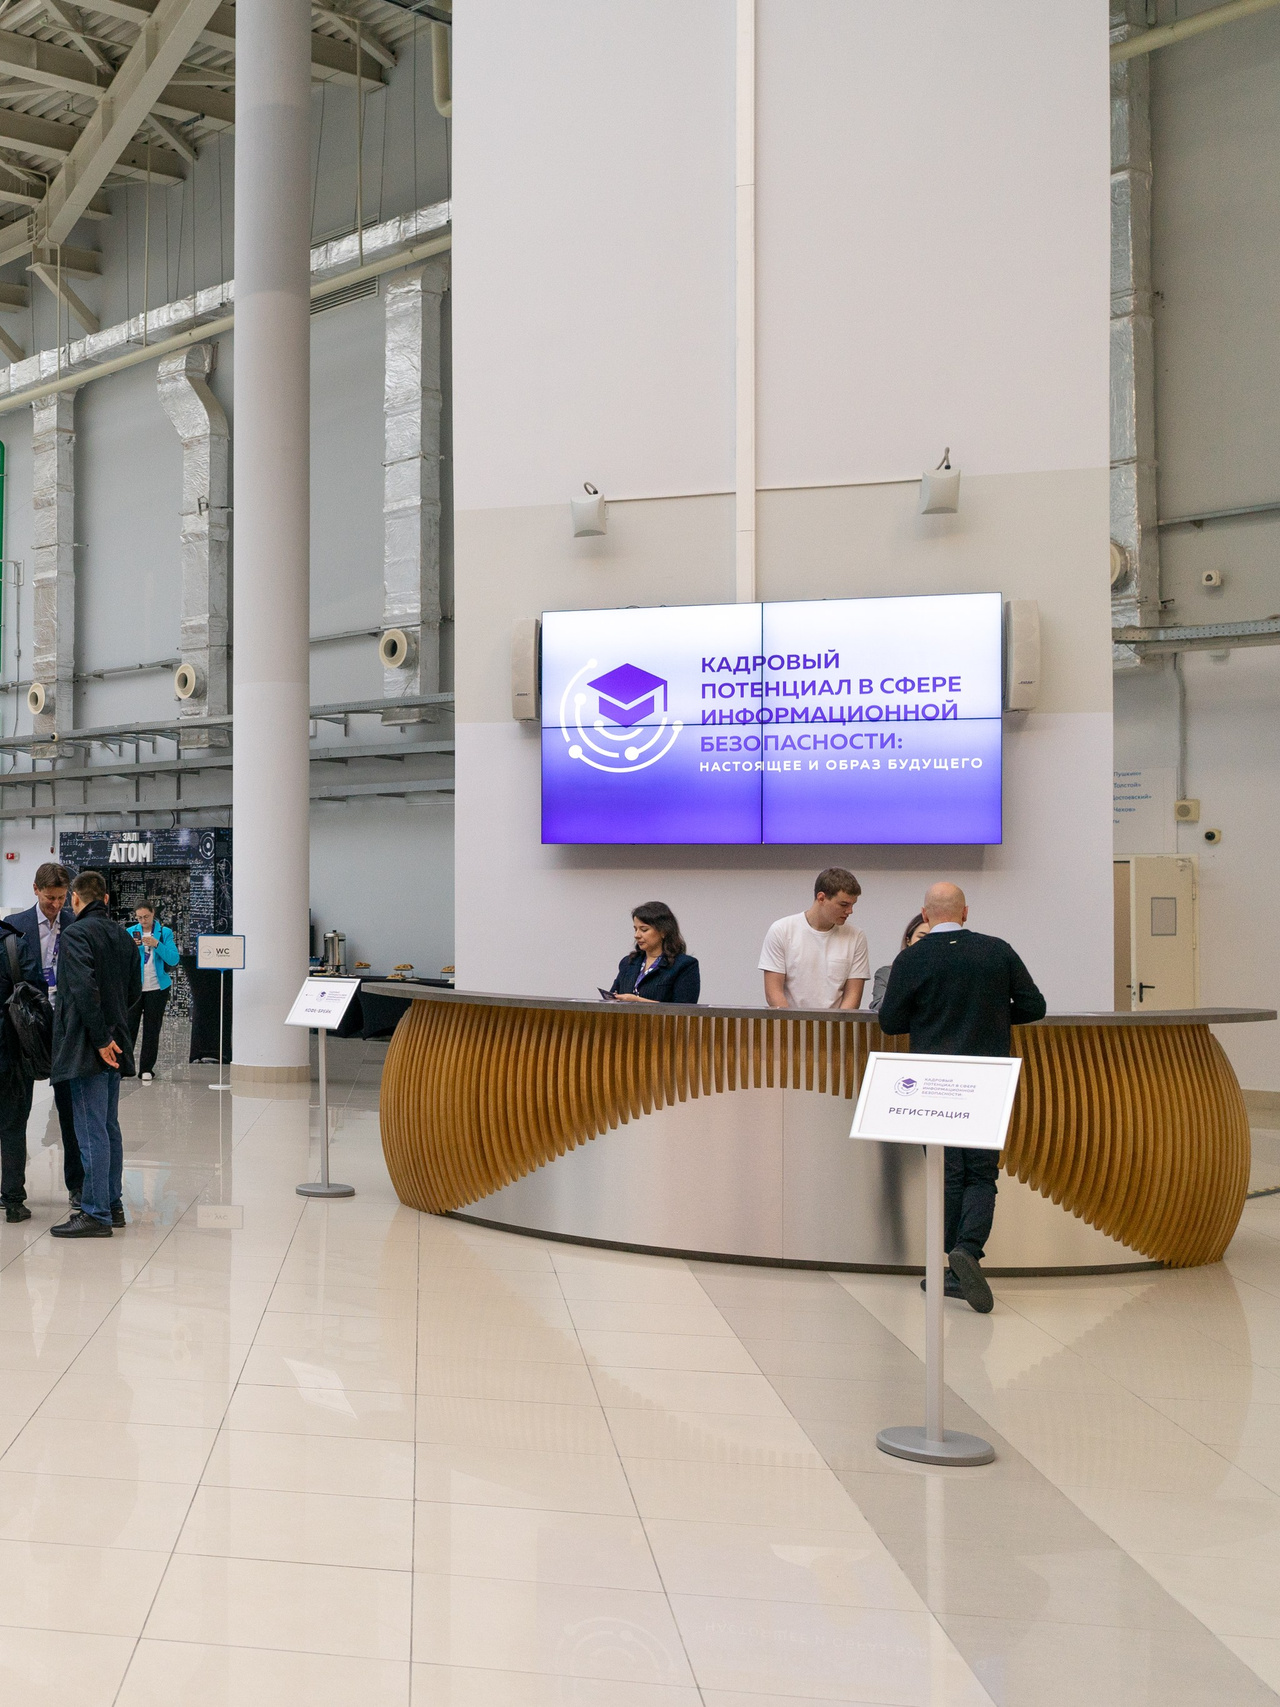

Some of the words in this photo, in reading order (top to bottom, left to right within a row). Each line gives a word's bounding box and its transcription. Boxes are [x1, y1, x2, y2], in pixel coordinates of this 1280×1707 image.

[701, 649, 840, 675] КАДРОВЫЙ
[701, 679, 851, 699] ПОТЕНЦИАЛ
[859, 678, 874, 695] В
[880, 676, 962, 695] СФЕРЕ
[701, 699, 958, 725] ИНФОРМАЦИОННОЙ
[700, 733, 903, 752] БЕЗОПАСНОСТИ:
[699, 760, 802, 772] НАСТОЯЩЕЕ
[808, 760, 819, 770] И
[825, 759, 881, 770] ОБРАЗ
[888, 758, 983, 771] БУДУЩЕГО
[122, 832, 139, 841] ЗАЛ
[109, 843, 153, 862] АТОМ
[888, 1107, 970, 1119] РЕГИСТРАЦИЯ
